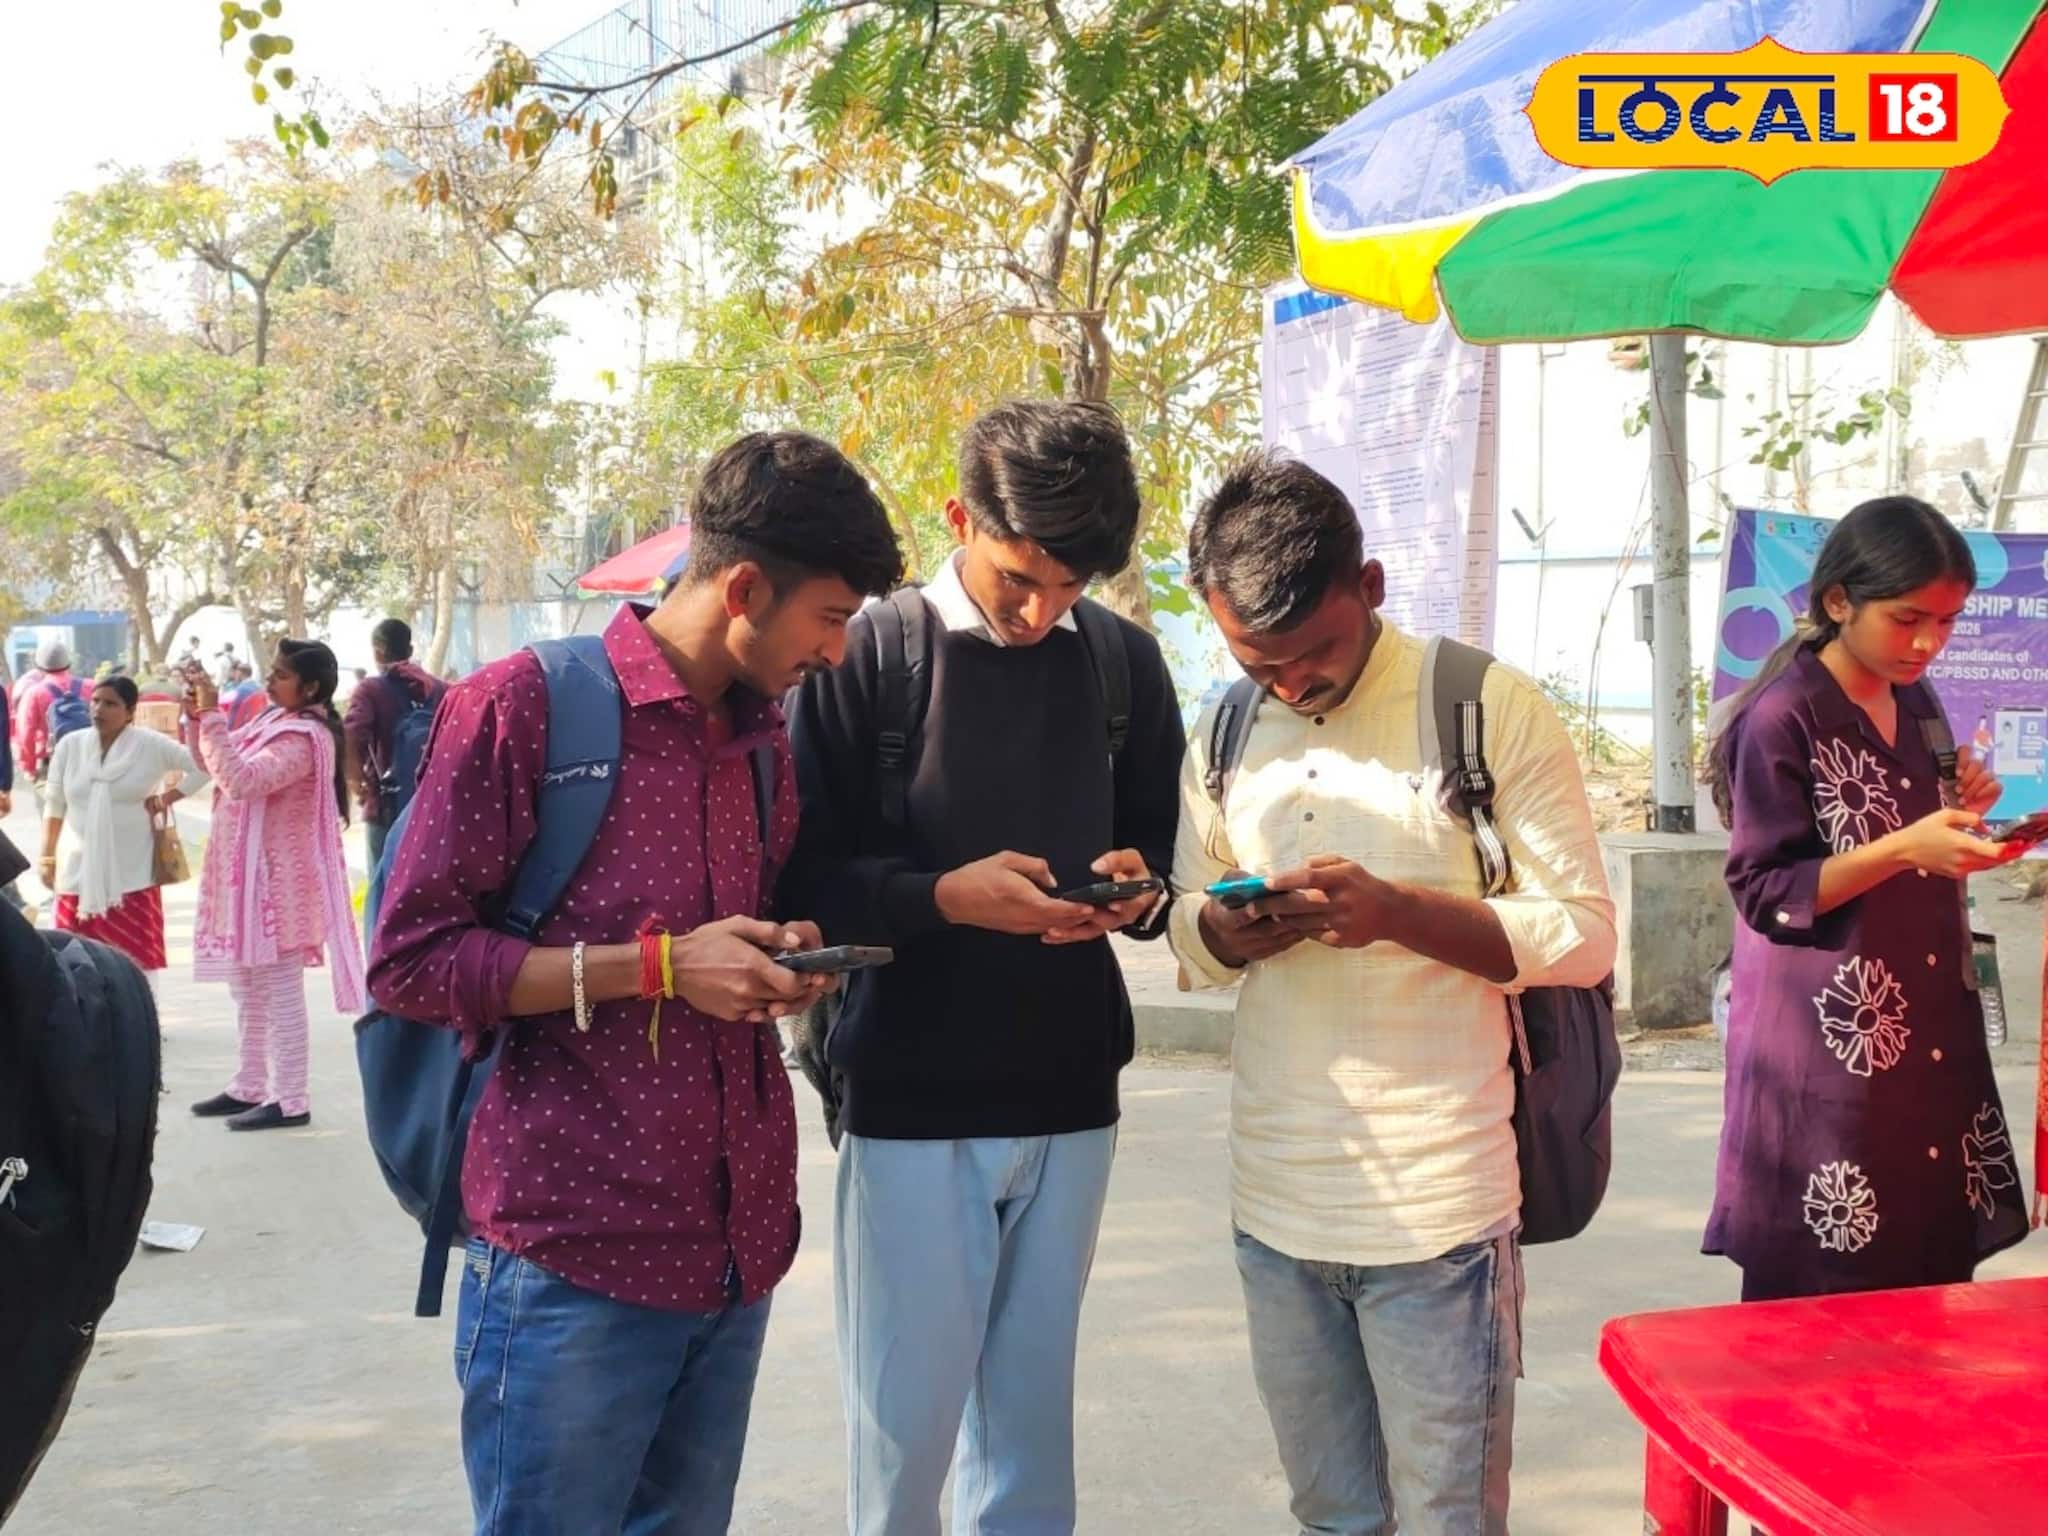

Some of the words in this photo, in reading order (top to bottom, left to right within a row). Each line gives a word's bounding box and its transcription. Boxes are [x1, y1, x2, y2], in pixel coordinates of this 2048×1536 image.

[1964, 595, 2012, 616] SHIP
[1947, 648, 2013, 662] candidates
[2015, 650, 2029, 663] of
[1926, 665, 1989, 680] TC/PBSSD
[1992, 667, 2020, 681] AND
